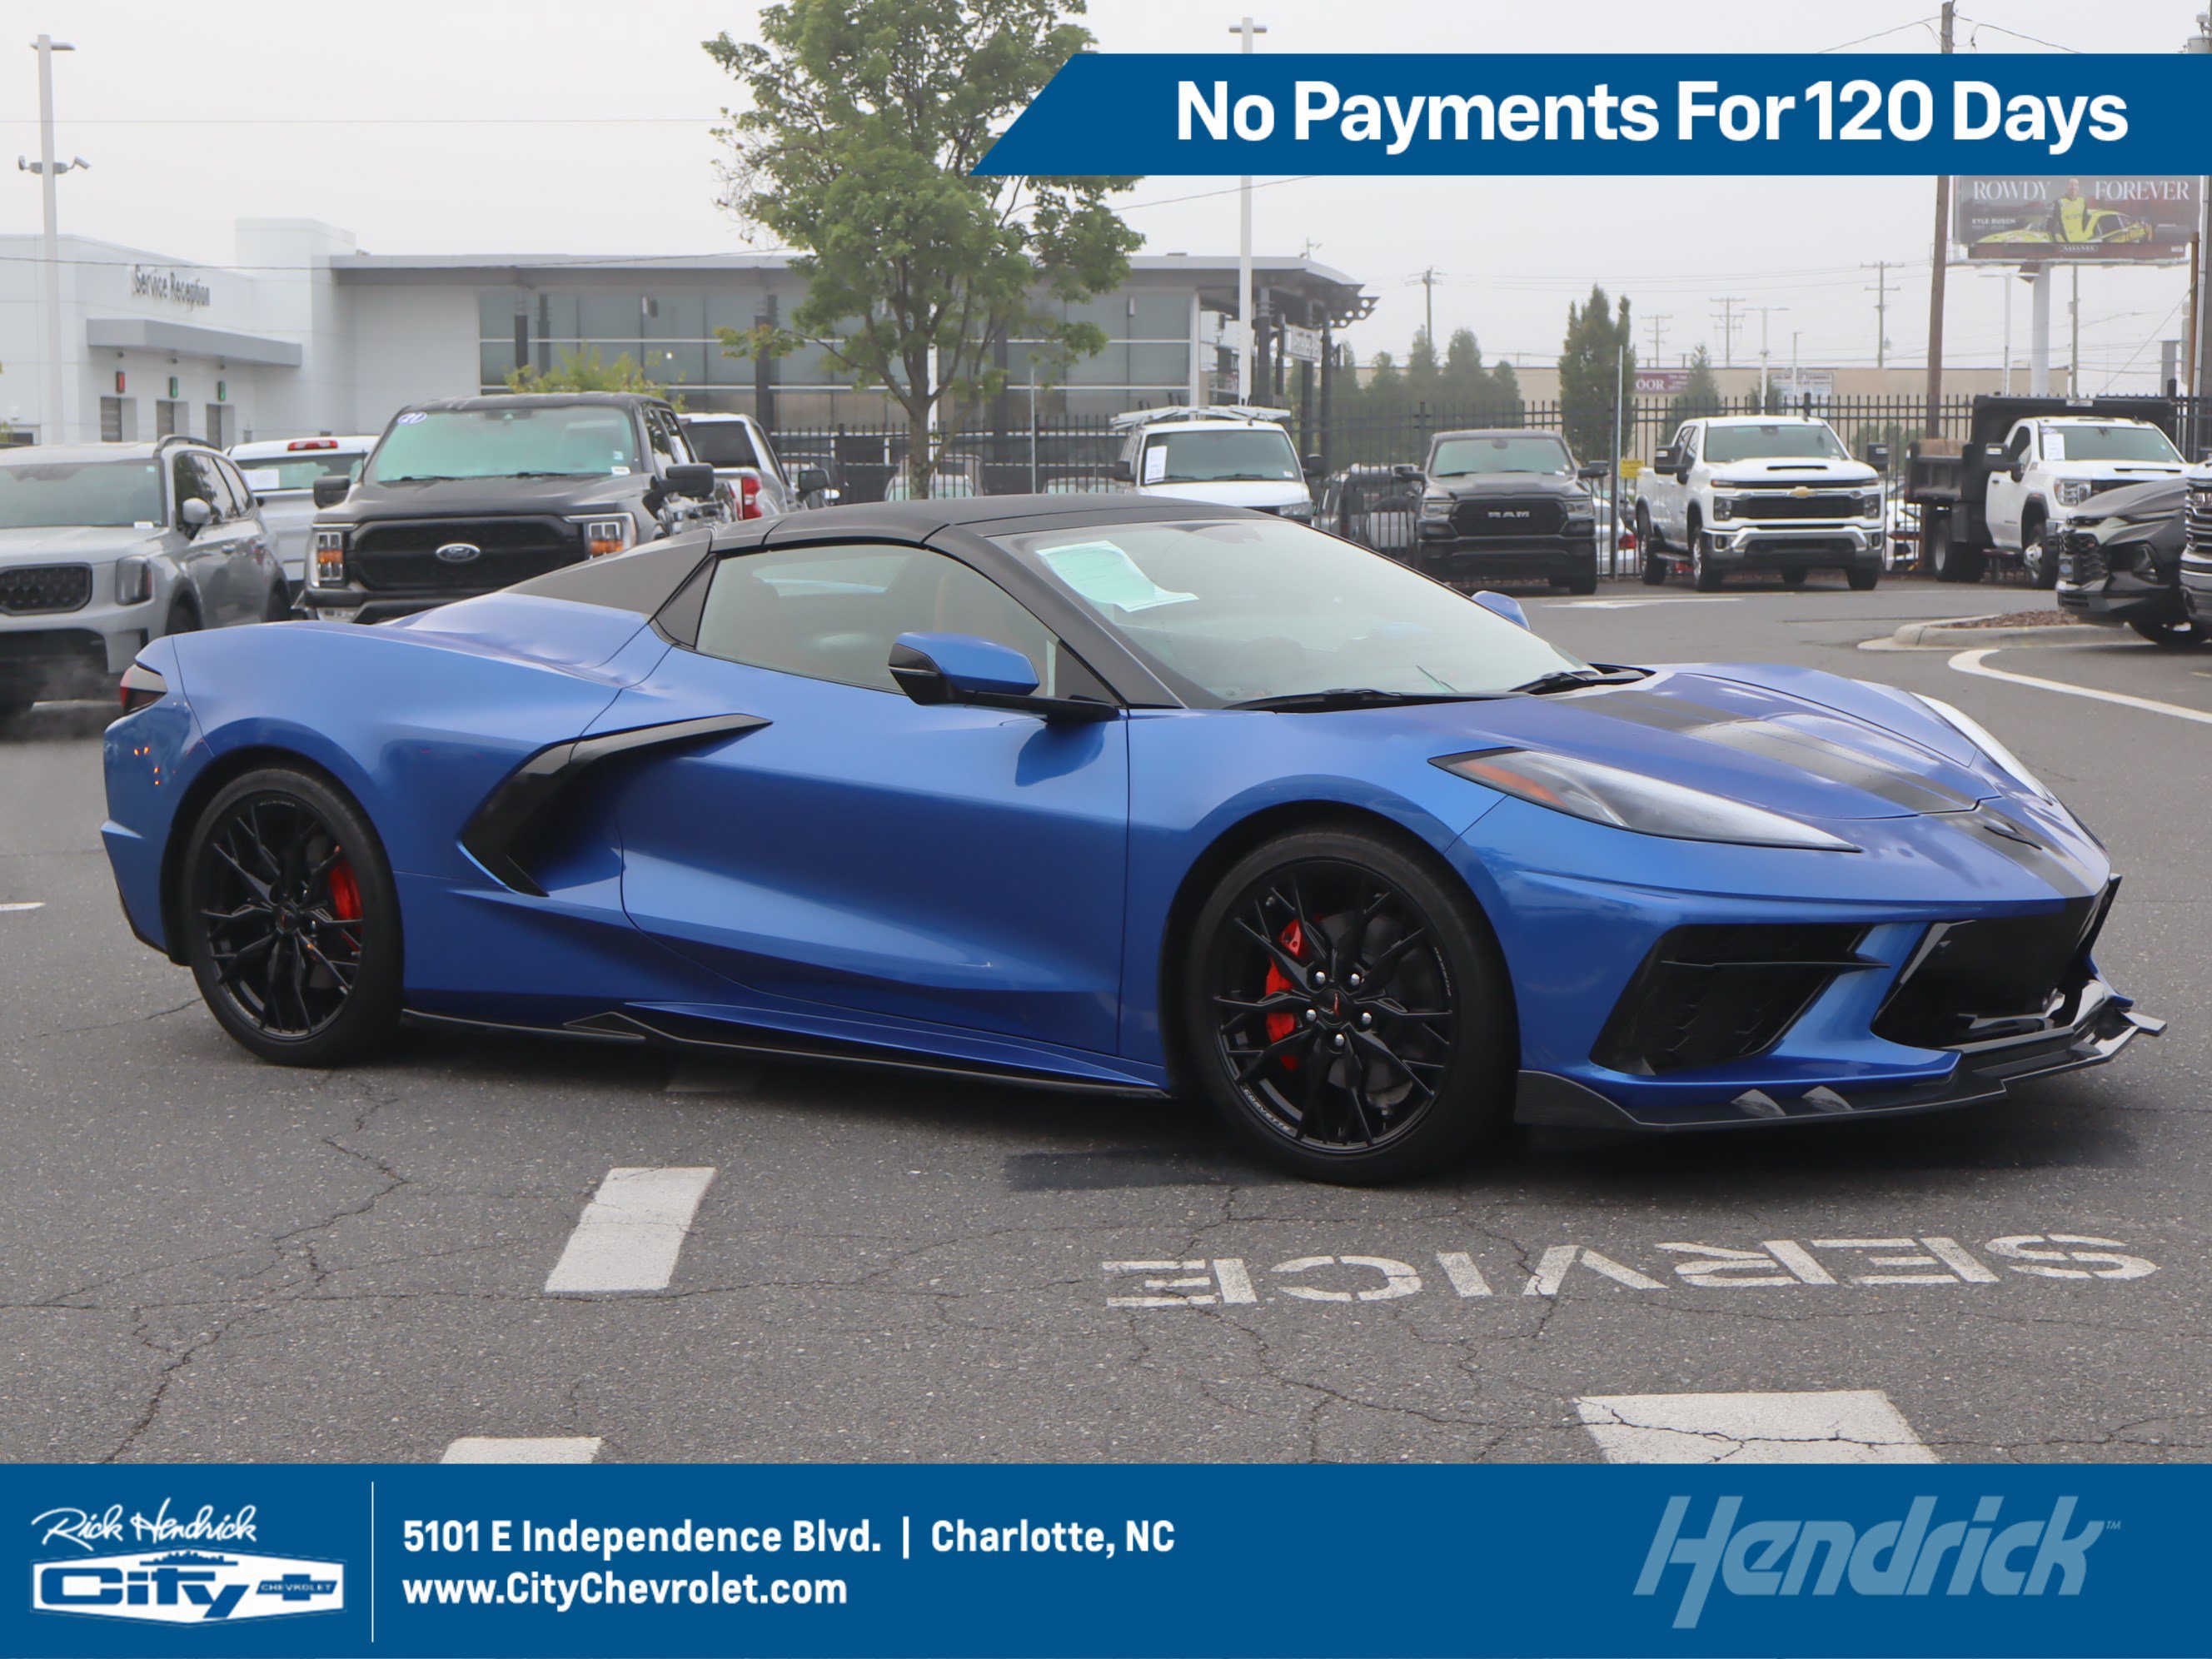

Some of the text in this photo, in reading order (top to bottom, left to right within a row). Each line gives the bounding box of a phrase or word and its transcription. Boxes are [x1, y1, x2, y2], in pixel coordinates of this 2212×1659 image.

[1973, 181, 2190, 201] ROWDY FOREVER
[134, 264, 210, 311] Service Reception
[1487, 510, 1530, 518] RAM
[1243, 1089, 1290, 1131] CORVETTE
[1102, 1233, 2160, 1308] SERVICE
